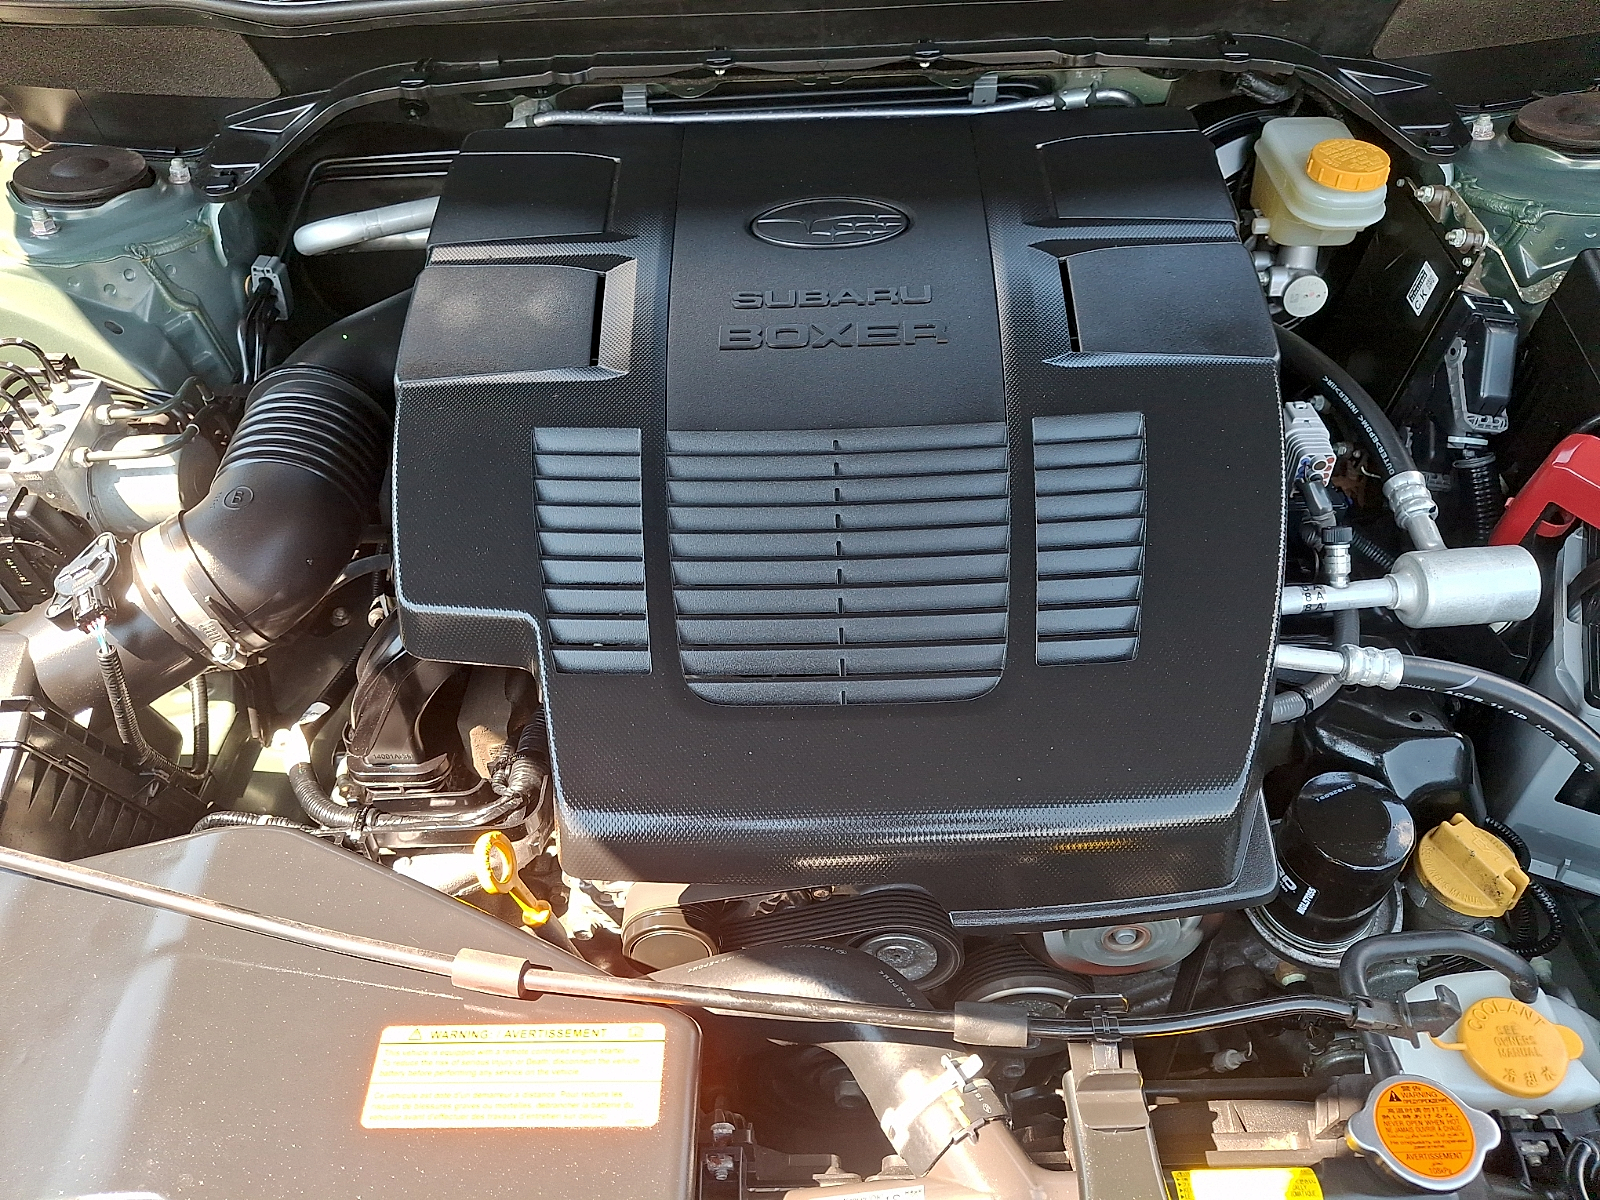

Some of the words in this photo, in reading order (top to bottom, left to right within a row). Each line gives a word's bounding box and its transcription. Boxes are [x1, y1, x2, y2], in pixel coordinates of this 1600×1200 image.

[731, 284, 932, 309] SUBARU
[719, 318, 949, 350] BOXER
[1467, 1000, 1546, 1031] COOLANT
[503, 1028, 608, 1040] AVERTISSEMENT
[1400, 1091, 1438, 1099] WARNING
[1383, 1119, 1405, 1127] NEVER
[1405, 1152, 1464, 1161] AVERTISSEMENT
